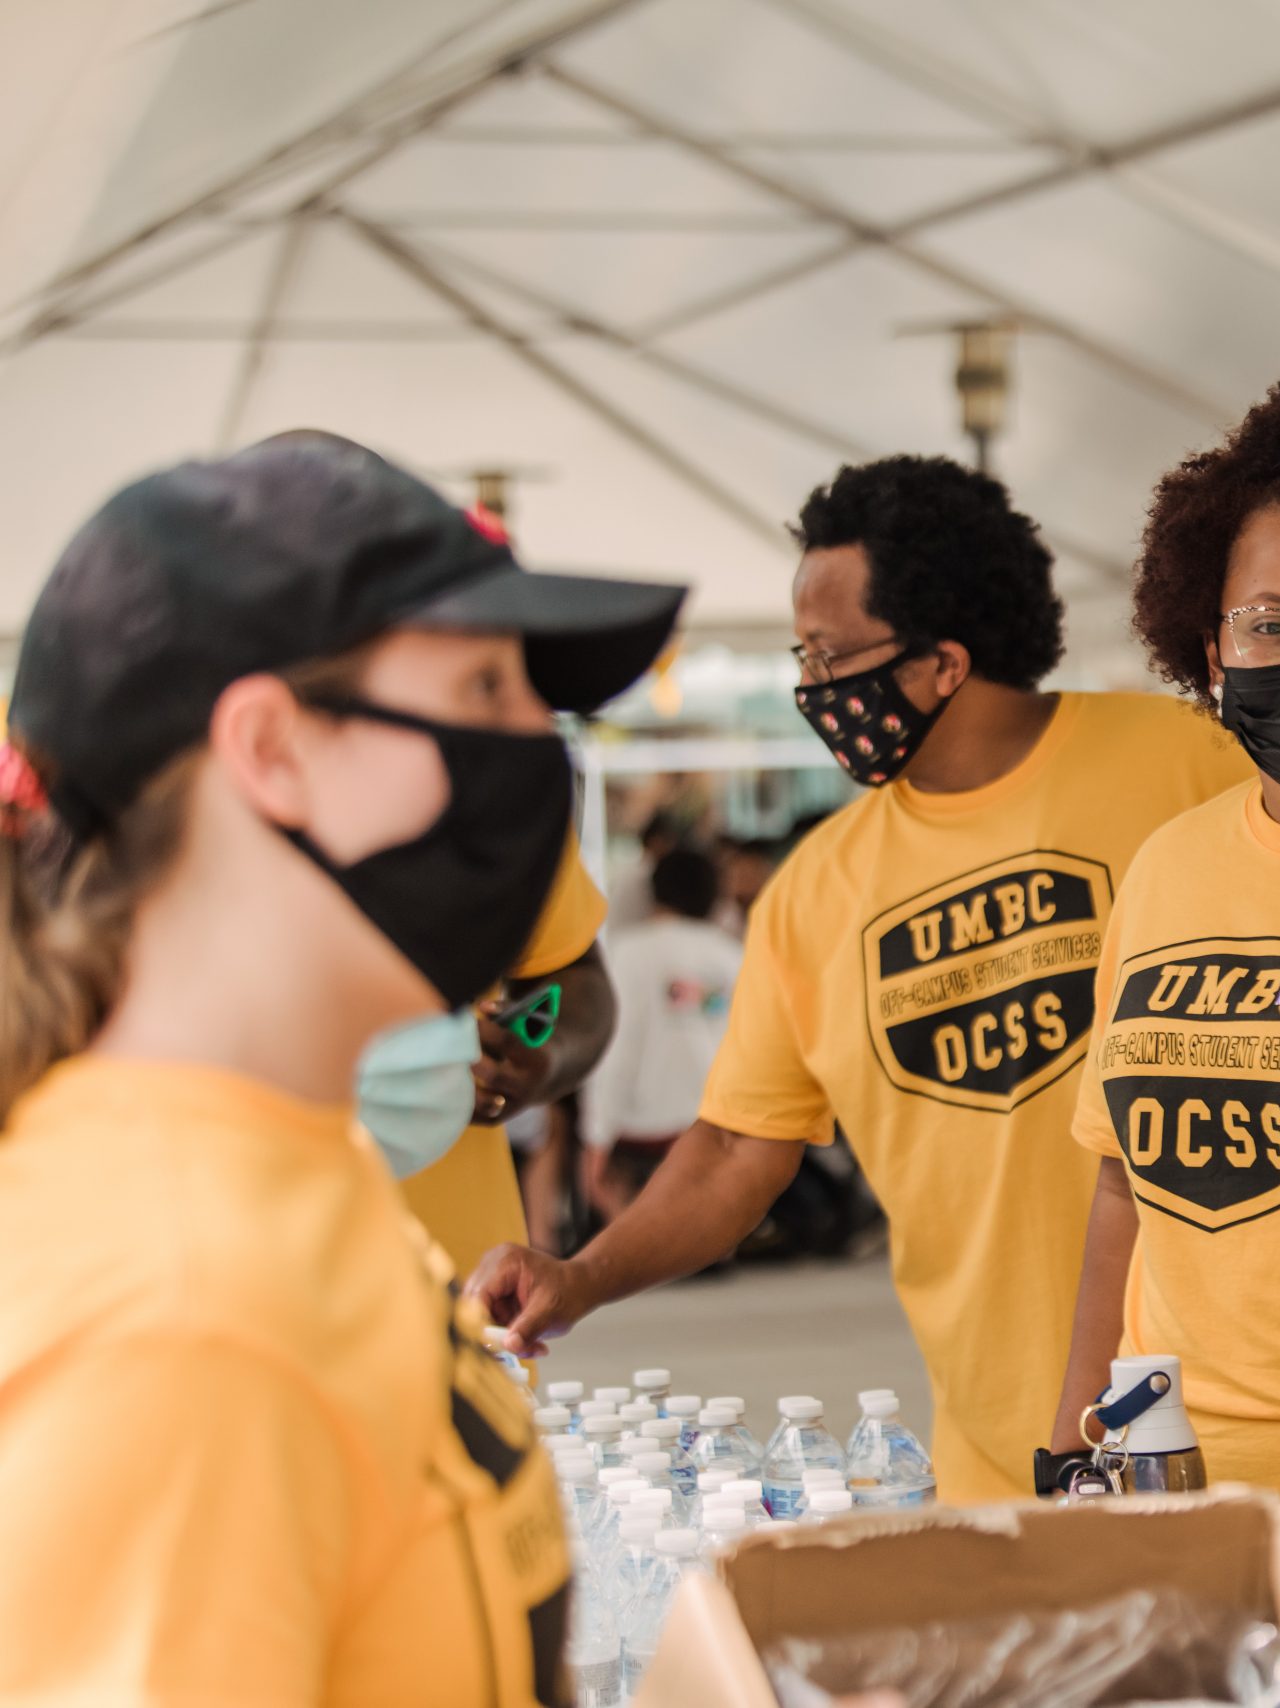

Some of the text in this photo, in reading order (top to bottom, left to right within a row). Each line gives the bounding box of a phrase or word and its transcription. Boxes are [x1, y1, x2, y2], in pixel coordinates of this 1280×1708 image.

[908, 873, 1056, 962] UMBC
[880, 932, 1101, 1018] OFF-CAMPUS STUDENT SERVICES
[933, 991, 1067, 1082] OCSS
[1189, 1034, 1260, 1068] STUDENT
